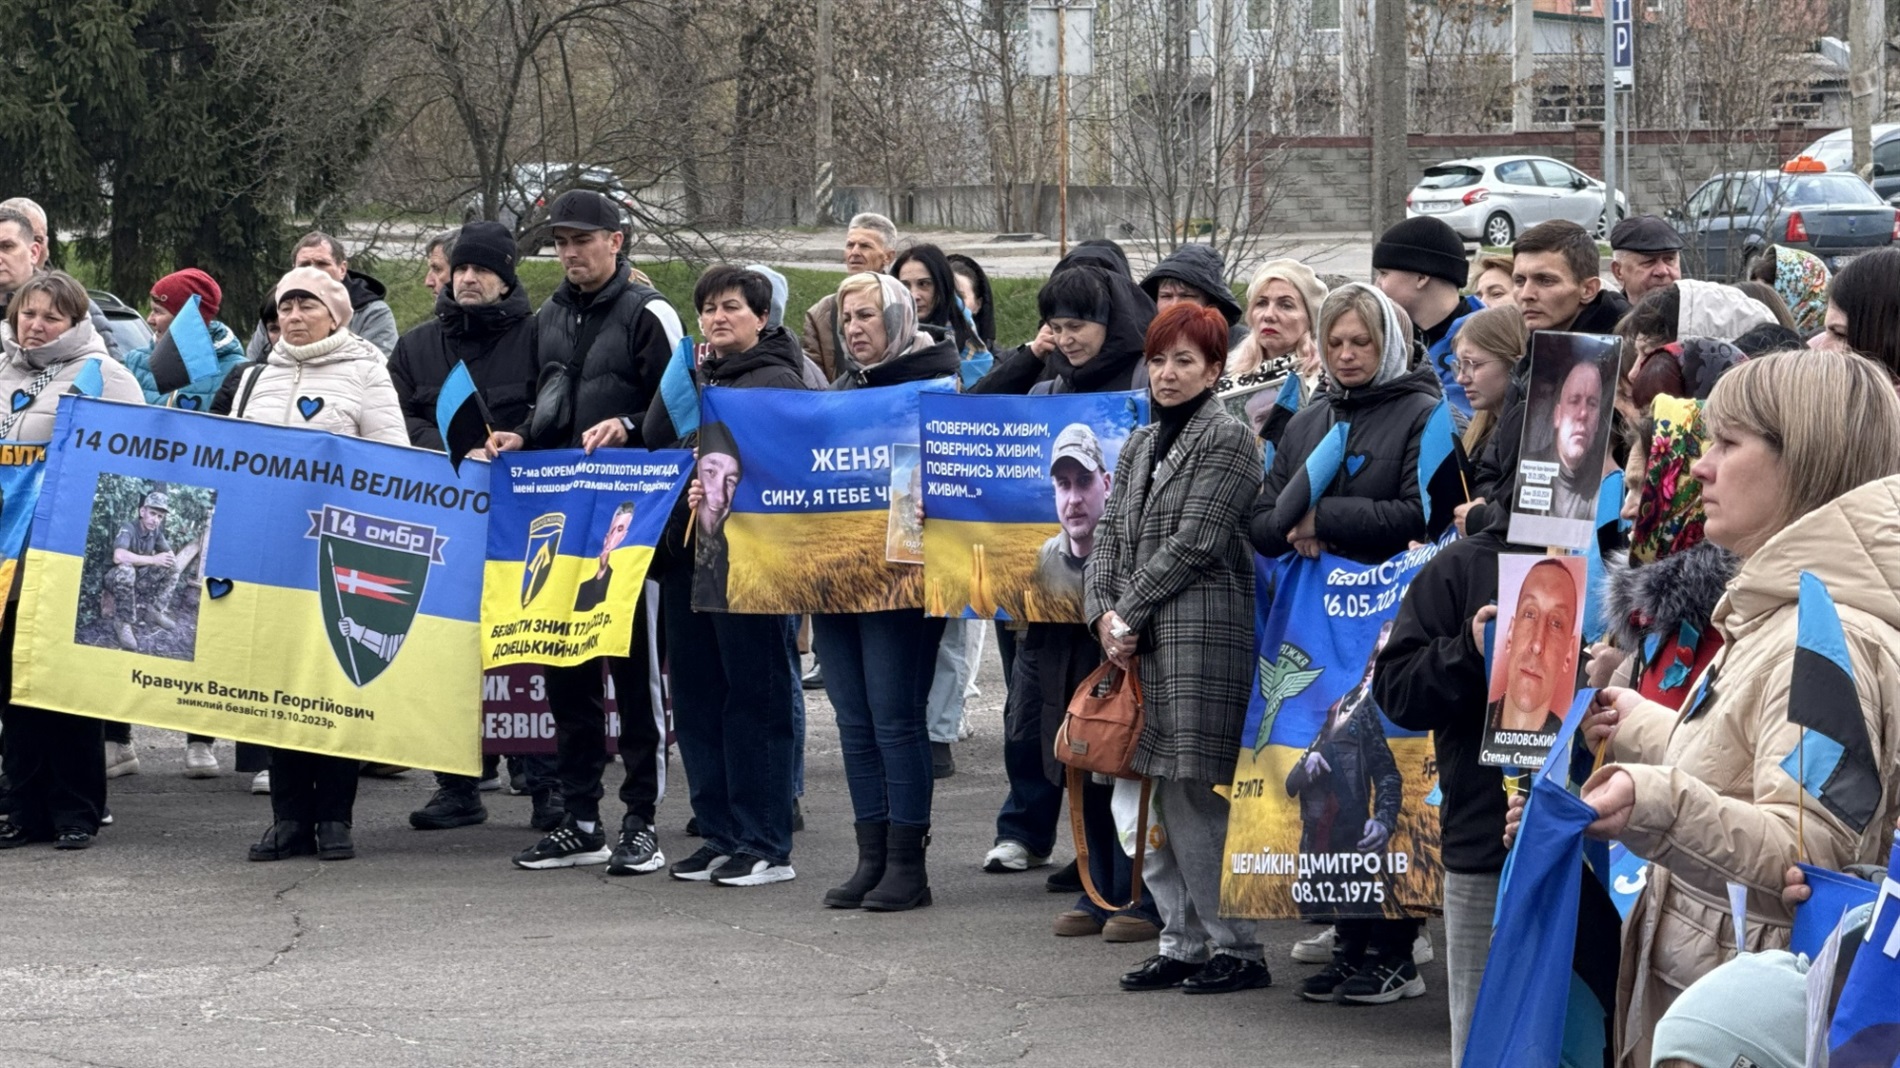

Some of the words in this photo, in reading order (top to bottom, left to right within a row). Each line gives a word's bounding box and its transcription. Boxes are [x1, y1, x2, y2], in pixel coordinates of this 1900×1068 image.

[1002, 422, 1051, 439] ЖИВИМ,
[811, 446, 889, 472] ЖЕНЯ
[925, 440, 993, 457] ПОВЕРНИСЬ
[995, 442, 1044, 459] ЖИВИМ,
[73, 428, 101, 452] 14
[107, 432, 187, 468] ОМБР
[193, 444, 345, 488] ІМ.РОМАНА
[350, 468, 490, 516] ВЕЛИКОГО
[511, 466, 540, 478] 57-ма
[643, 463, 680, 477] БРИГАДА
[926, 461, 993, 478] ПОВЕРНИСЬ
[995, 463, 1045, 480] ЖИВИМ,
[512, 481, 535, 493] імені
[614, 479, 638, 492] Костя
[761, 488, 809, 508] СИНУ,
[813, 488, 824, 505] Я
[824, 486, 871, 504] ТЕБЕ
[874, 486, 892, 501] Ч
[330, 510, 357, 537] 14
[131, 669, 204, 694] Кравчук
[207, 680, 269, 703] Василь
[273, 689, 375, 721] Георгійович
[176, 696, 223, 714] зниклий
[225, 701, 268, 719] безвісті
[270, 709, 337, 730] 19.10.2023р.
[1494, 731, 1557, 747] КОЗЛОВСЬКИЙ
[1481, 750, 1511, 763] Степан
[1298, 852, 1381, 879] ДМИТРО
[1387, 852, 1408, 873] ІВ
[1291, 882, 1385, 904] 08.12.1975
